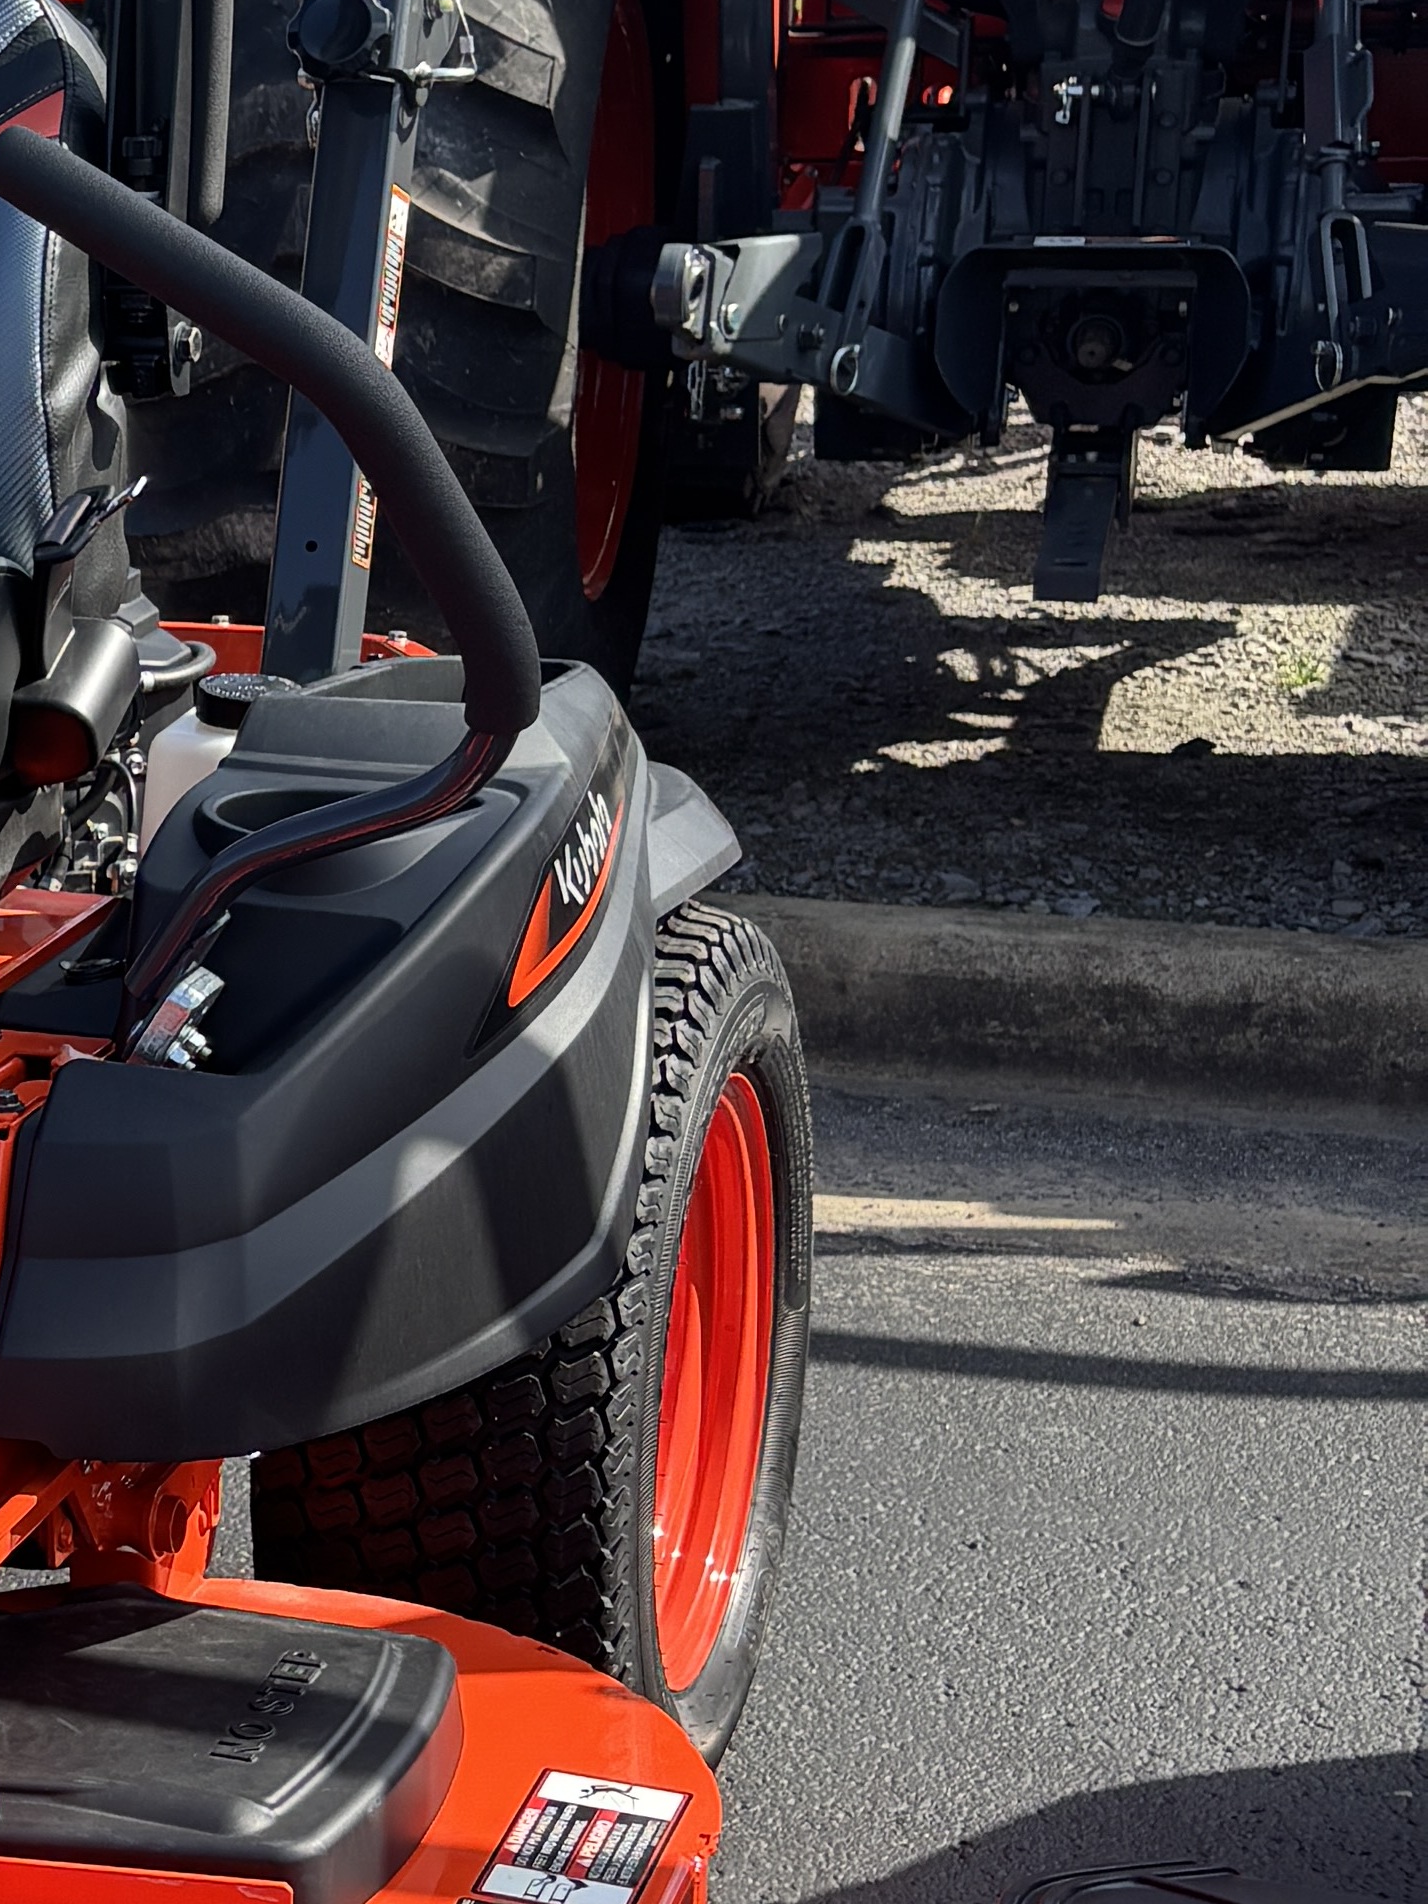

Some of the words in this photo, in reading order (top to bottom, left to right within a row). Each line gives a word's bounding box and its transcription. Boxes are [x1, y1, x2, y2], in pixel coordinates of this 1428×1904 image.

[553, 790, 612, 905] Kubota
[209, 1722, 275, 1765] NO
[248, 1649, 328, 1717] STEP
[511, 1808, 541, 1850] DANGER
[580, 1819, 613, 1861] PELIGRO
